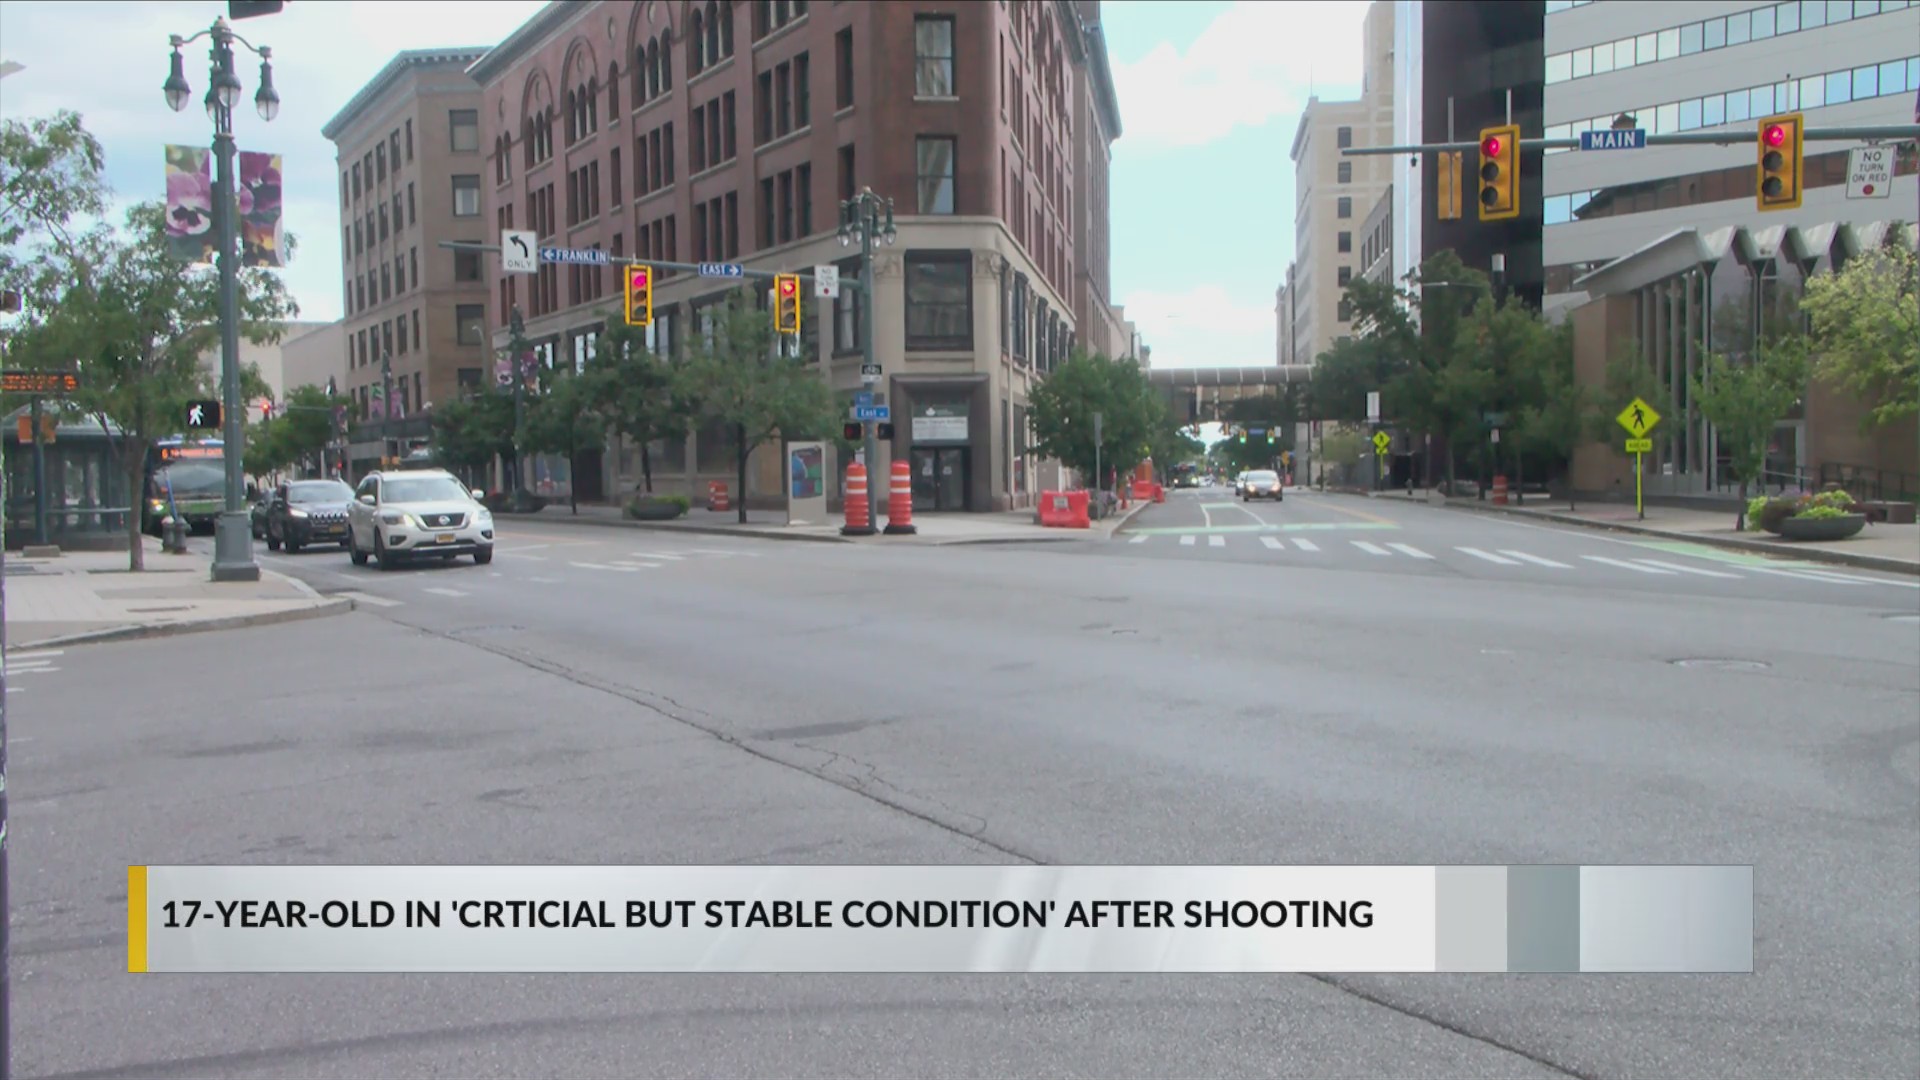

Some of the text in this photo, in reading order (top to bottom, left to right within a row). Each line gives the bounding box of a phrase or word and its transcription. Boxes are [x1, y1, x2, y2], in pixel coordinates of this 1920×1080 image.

[1591, 131, 1635, 149] MAIN
[1863, 151, 1882, 162] NO
[1860, 163, 1884, 172] TURN
[1852, 173, 1888, 183] ON RED
[556, 248, 608, 263] FRANKLIN
[507, 259, 532, 269] ONLY
[702, 263, 726, 275] EAST
